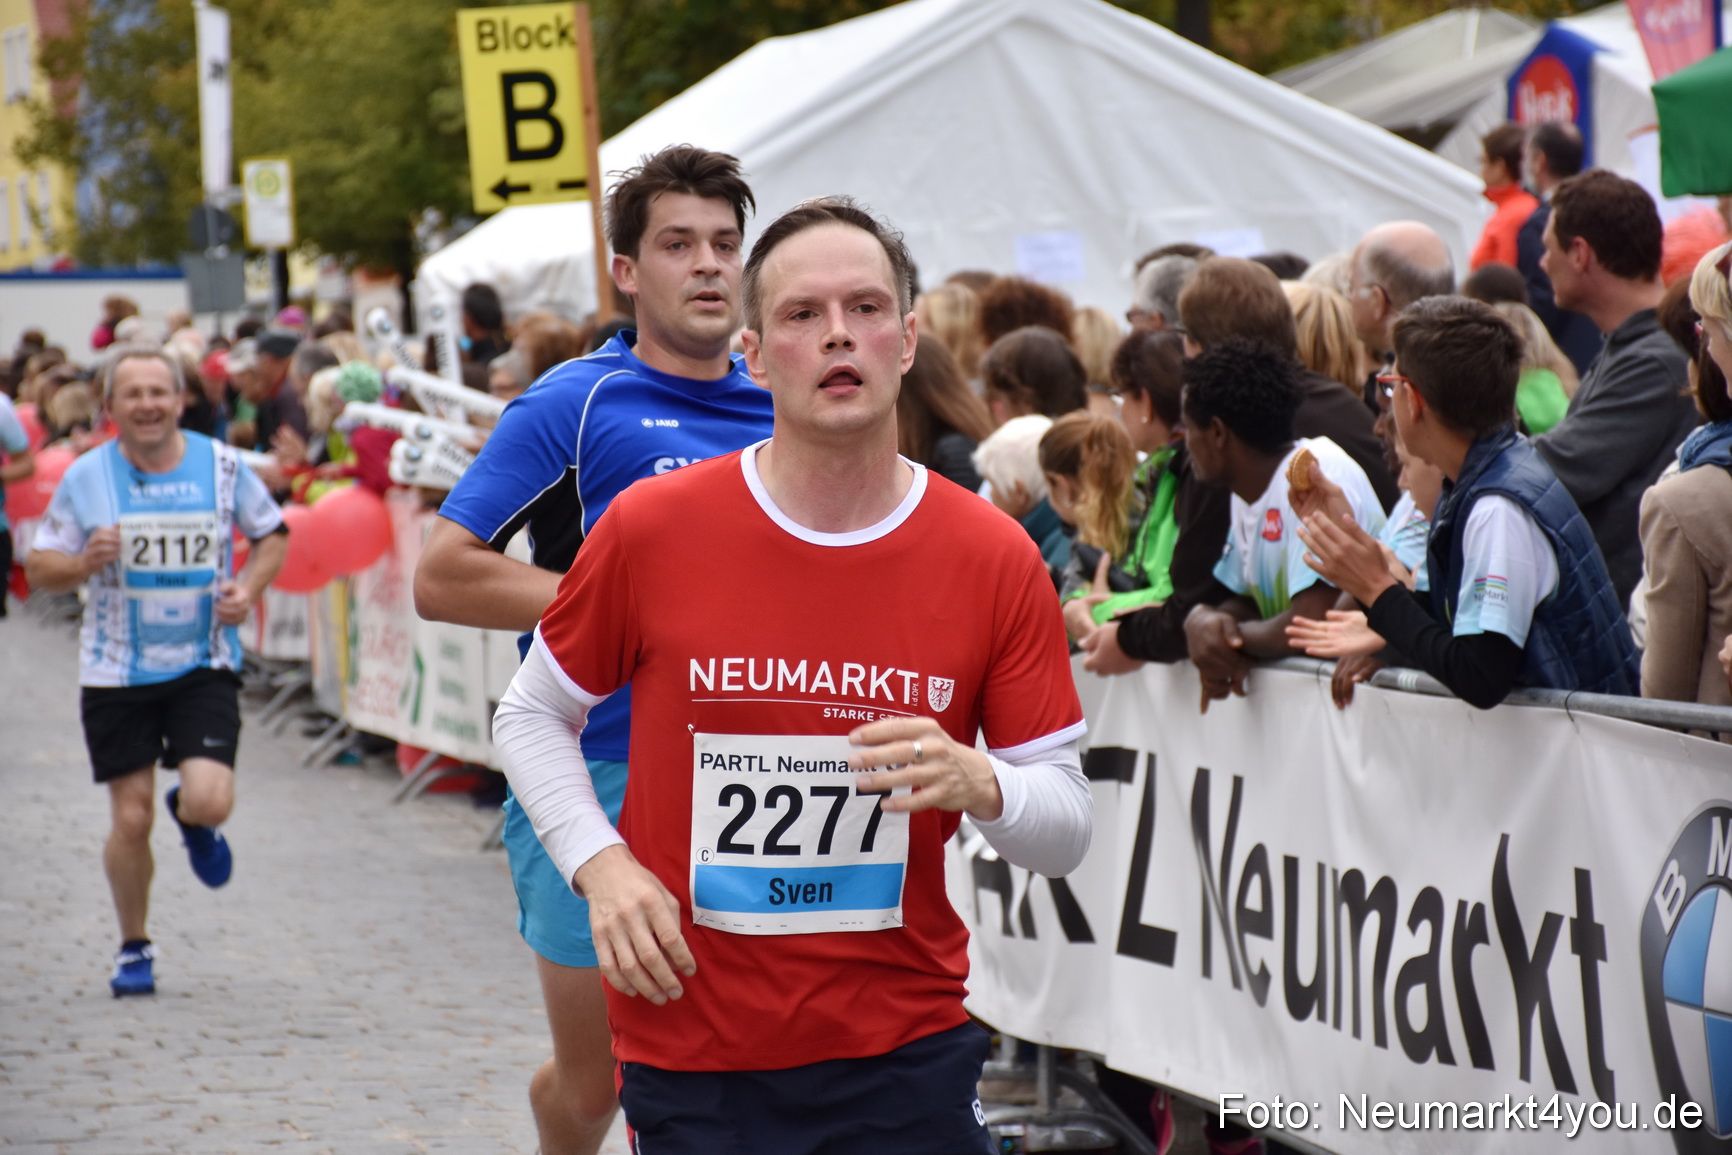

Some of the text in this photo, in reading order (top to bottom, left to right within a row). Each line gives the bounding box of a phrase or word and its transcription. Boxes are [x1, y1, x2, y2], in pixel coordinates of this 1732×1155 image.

[476, 14, 577, 53] Block
[500, 71, 565, 163] B
[655, 419, 679, 428] JAKO
[133, 534, 210, 566] 2112
[689, 657, 919, 705] NEUMARKT
[823, 707, 875, 722] STARKE
[700, 752, 877, 773] PARTL Neuma
[716, 783, 893, 856] 2277
[768, 877, 833, 906] Sven
[1190, 766, 1617, 1109] Neumarkt
